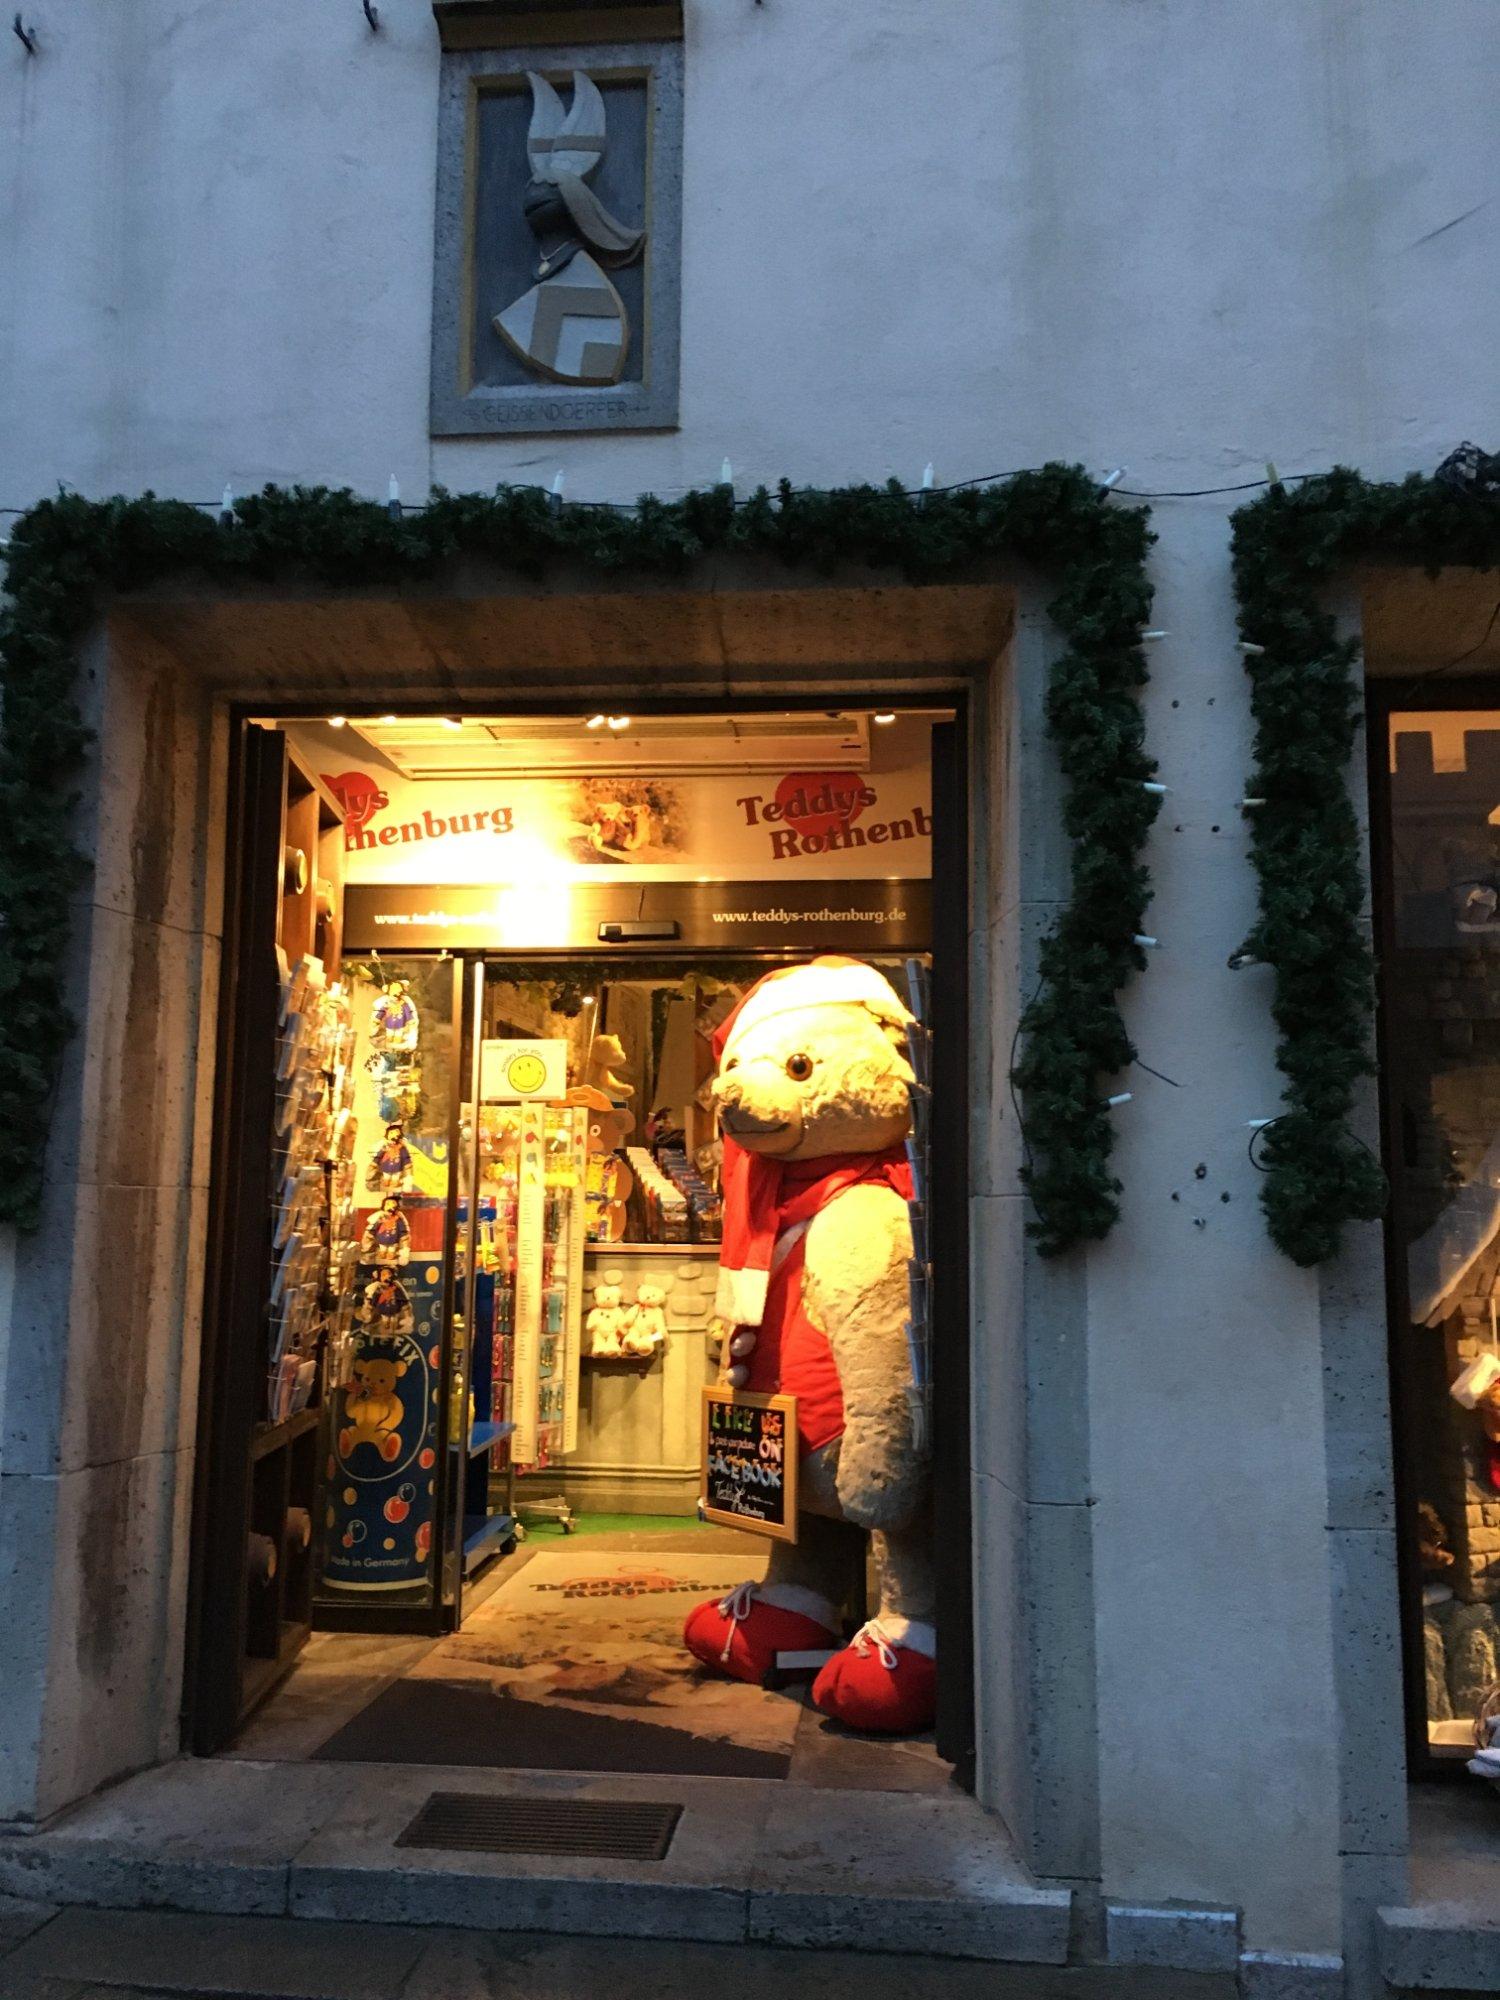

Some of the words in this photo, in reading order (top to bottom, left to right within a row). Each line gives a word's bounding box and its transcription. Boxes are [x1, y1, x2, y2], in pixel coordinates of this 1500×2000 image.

[736, 784, 878, 826] Teddys
[712, 908, 906, 924] www.teddys-rothenburg.de
[712, 1403, 754, 1433] LIKE
[761, 1412, 782, 1436] US
[759, 1435, 783, 1462] ON
[363, 1557, 409, 1568] Germany
